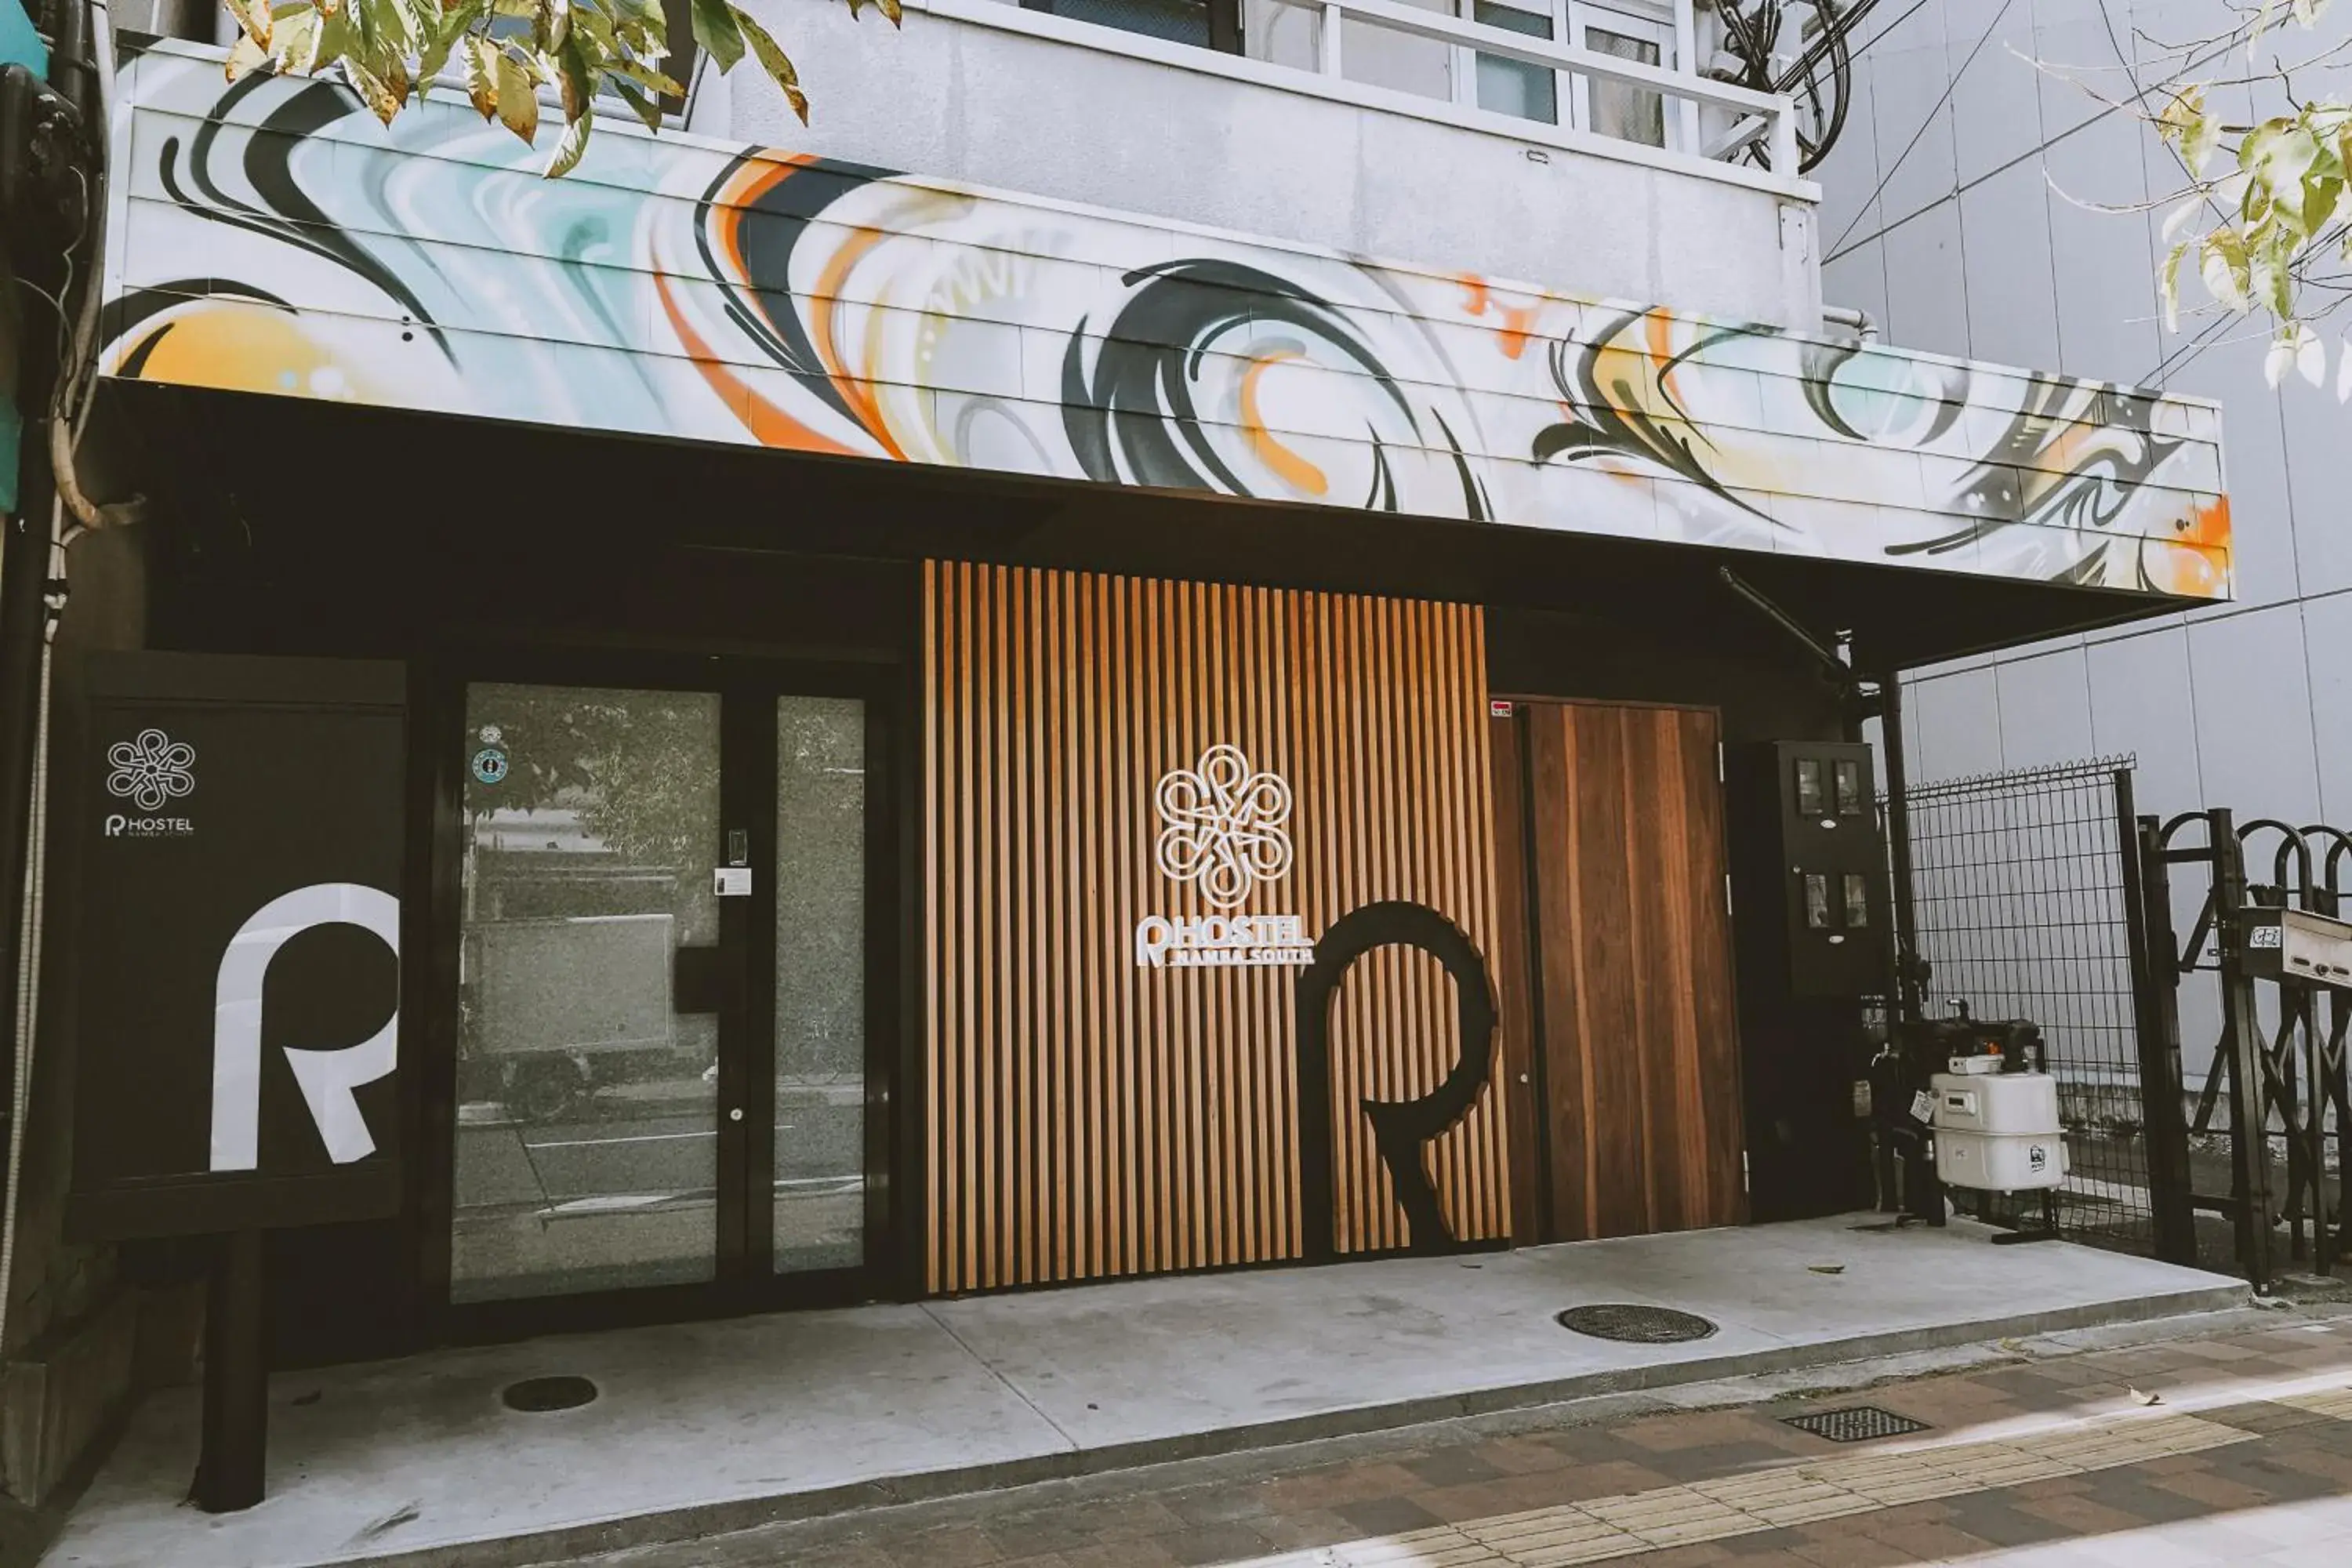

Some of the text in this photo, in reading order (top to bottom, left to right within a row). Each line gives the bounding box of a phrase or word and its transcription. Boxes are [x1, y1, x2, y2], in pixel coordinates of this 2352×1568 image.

[105, 814, 194, 837] R HOSTEL
[1137, 915, 1315, 967] R HOSTEL
[1248, 948, 1315, 965] SOUTH
[210, 882, 400, 1172] R
[1297, 901, 1500, 1250] R
